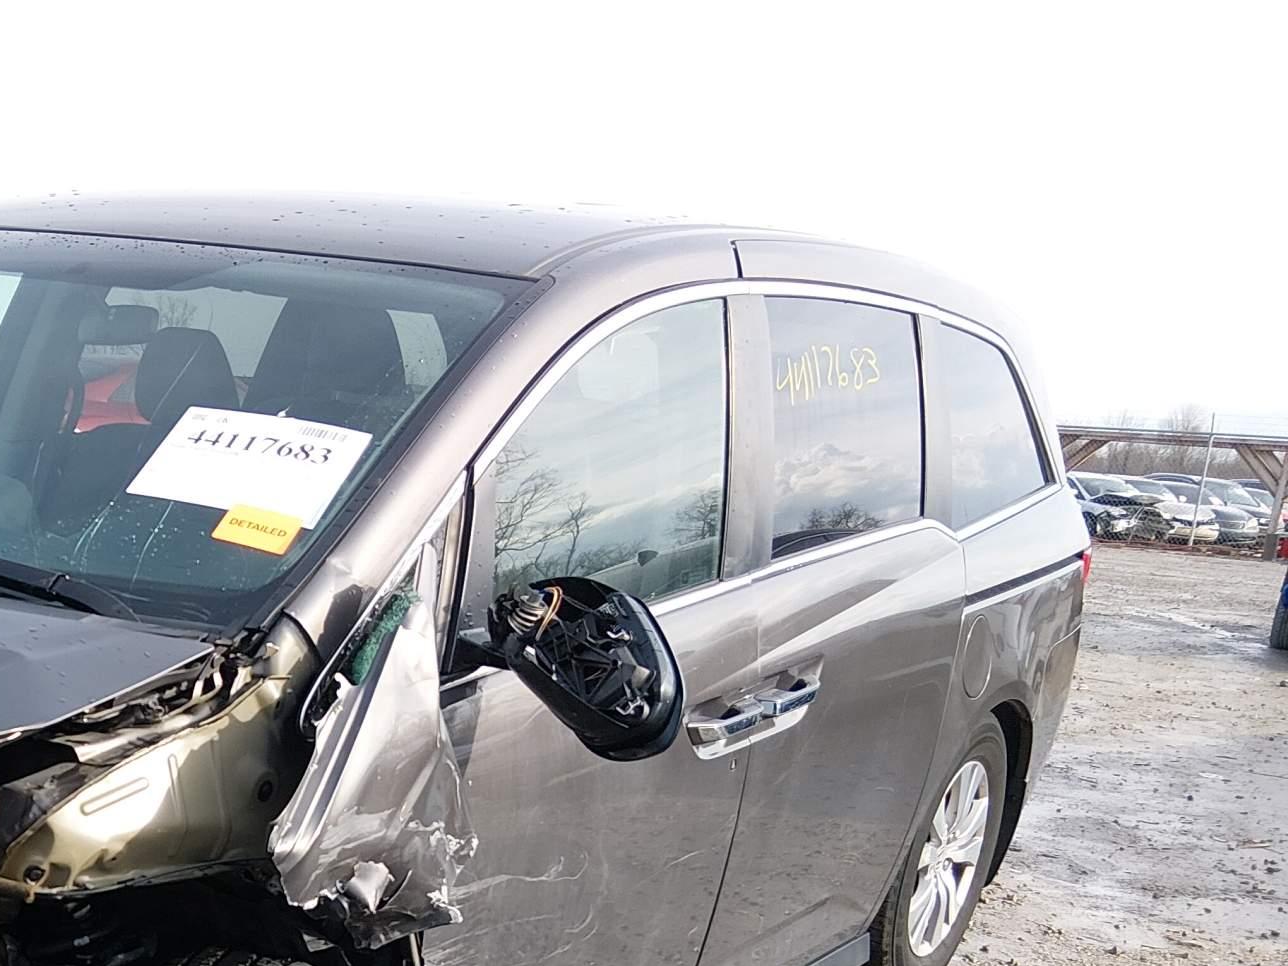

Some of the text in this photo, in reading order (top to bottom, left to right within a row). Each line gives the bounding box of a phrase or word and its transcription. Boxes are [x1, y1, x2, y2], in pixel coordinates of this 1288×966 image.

[775, 343, 881, 406] 44117683
[187, 429, 333, 465] 44117683
[228, 517, 288, 538] DETAILED
